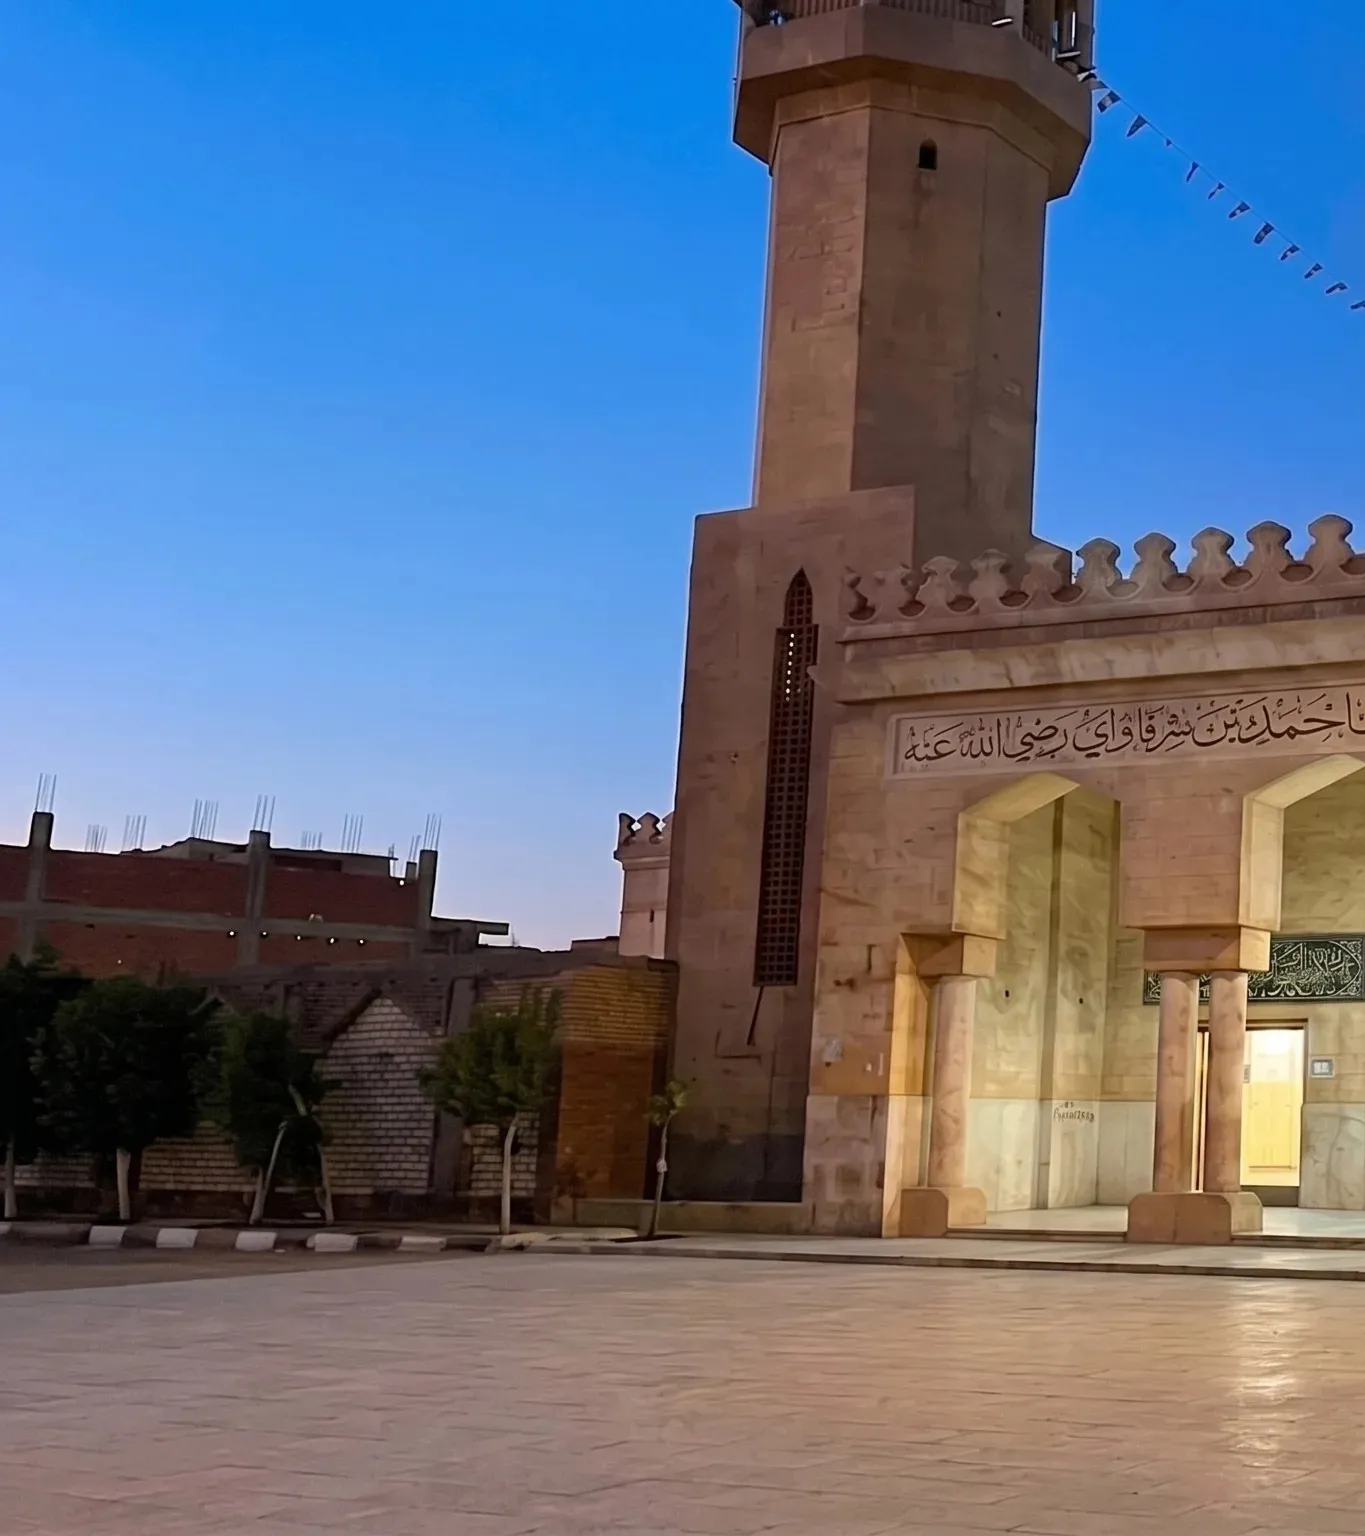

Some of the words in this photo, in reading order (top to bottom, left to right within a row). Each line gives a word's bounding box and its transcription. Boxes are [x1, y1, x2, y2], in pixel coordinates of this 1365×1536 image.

[904, 721, 962, 764] عنه
[959, 716, 1002, 761] الله
[1003, 710, 1074, 763] رضي
[1192, 698, 1240, 747] بن
